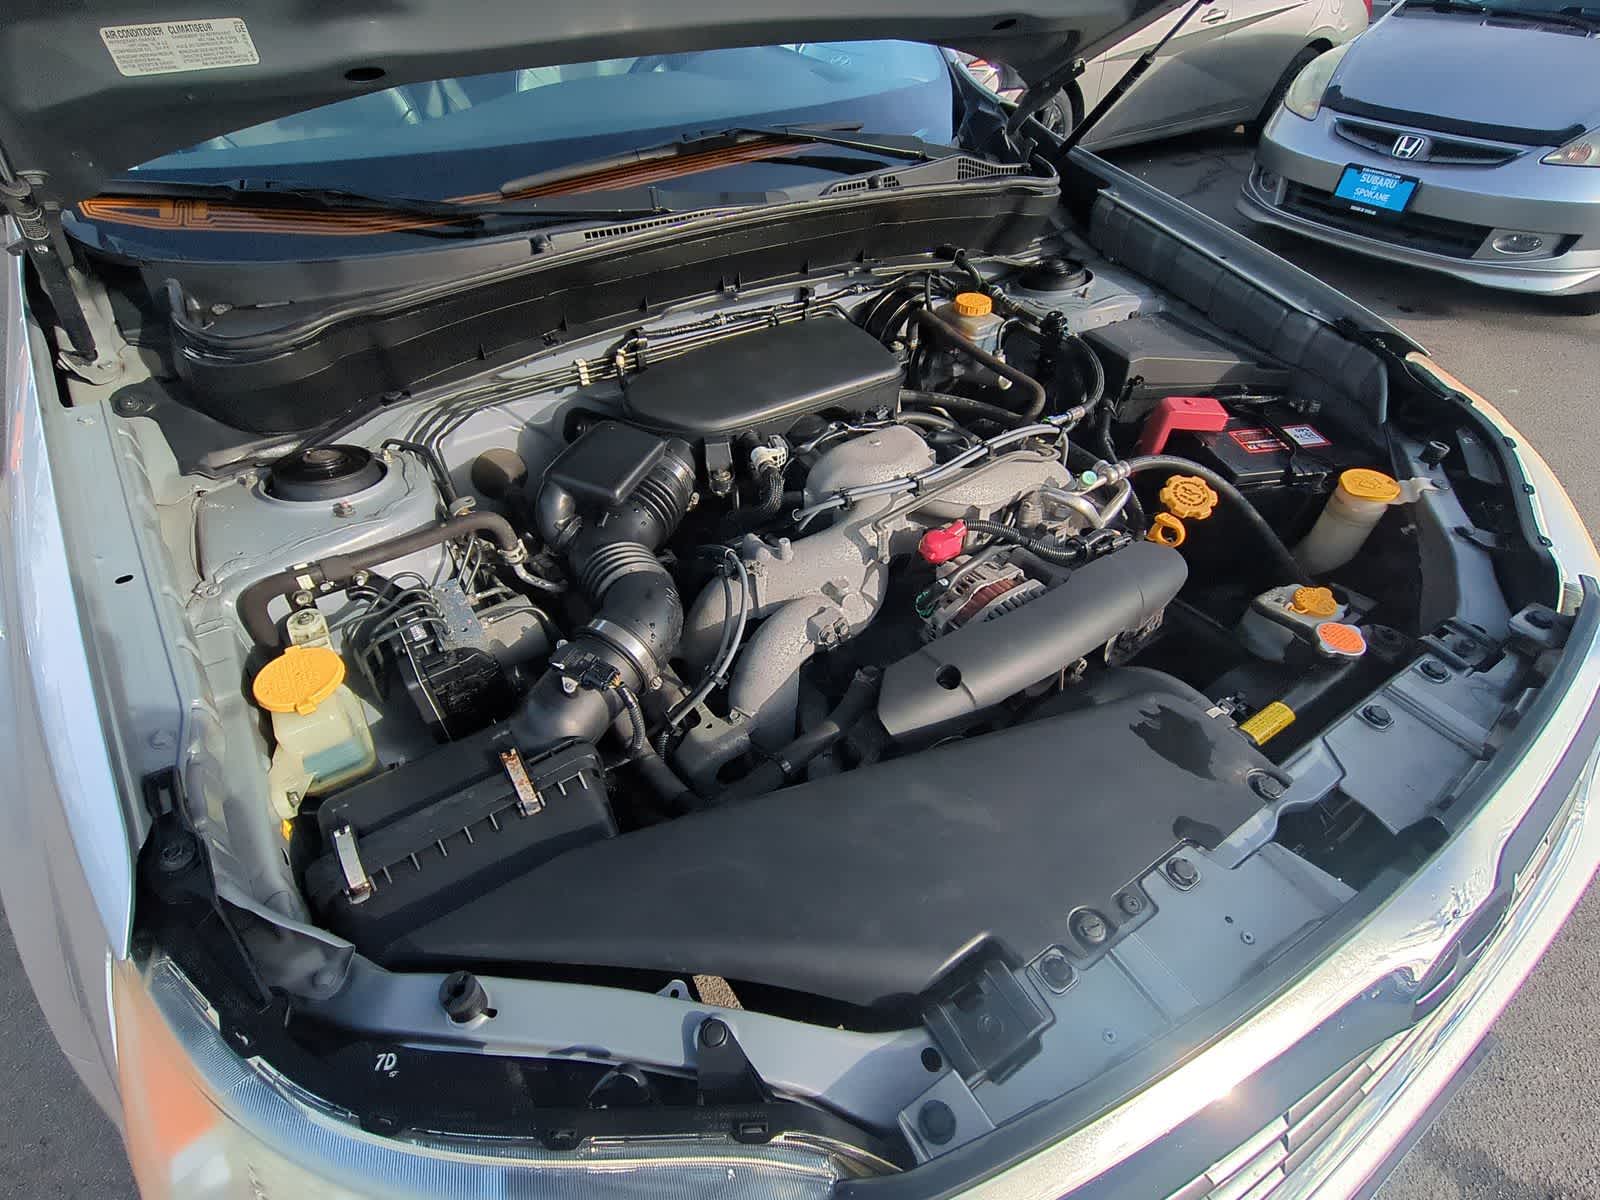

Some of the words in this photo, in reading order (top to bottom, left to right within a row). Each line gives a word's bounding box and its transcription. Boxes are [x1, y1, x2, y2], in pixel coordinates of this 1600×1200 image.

[105, 30, 117, 39] AIR
[117, 27, 162, 38] CONDITIONER
[168, 23, 213, 34] CLIMATISEUR
[1360, 173, 1397, 188] SUBARU
[1354, 187, 1390, 202] SPOKANE
